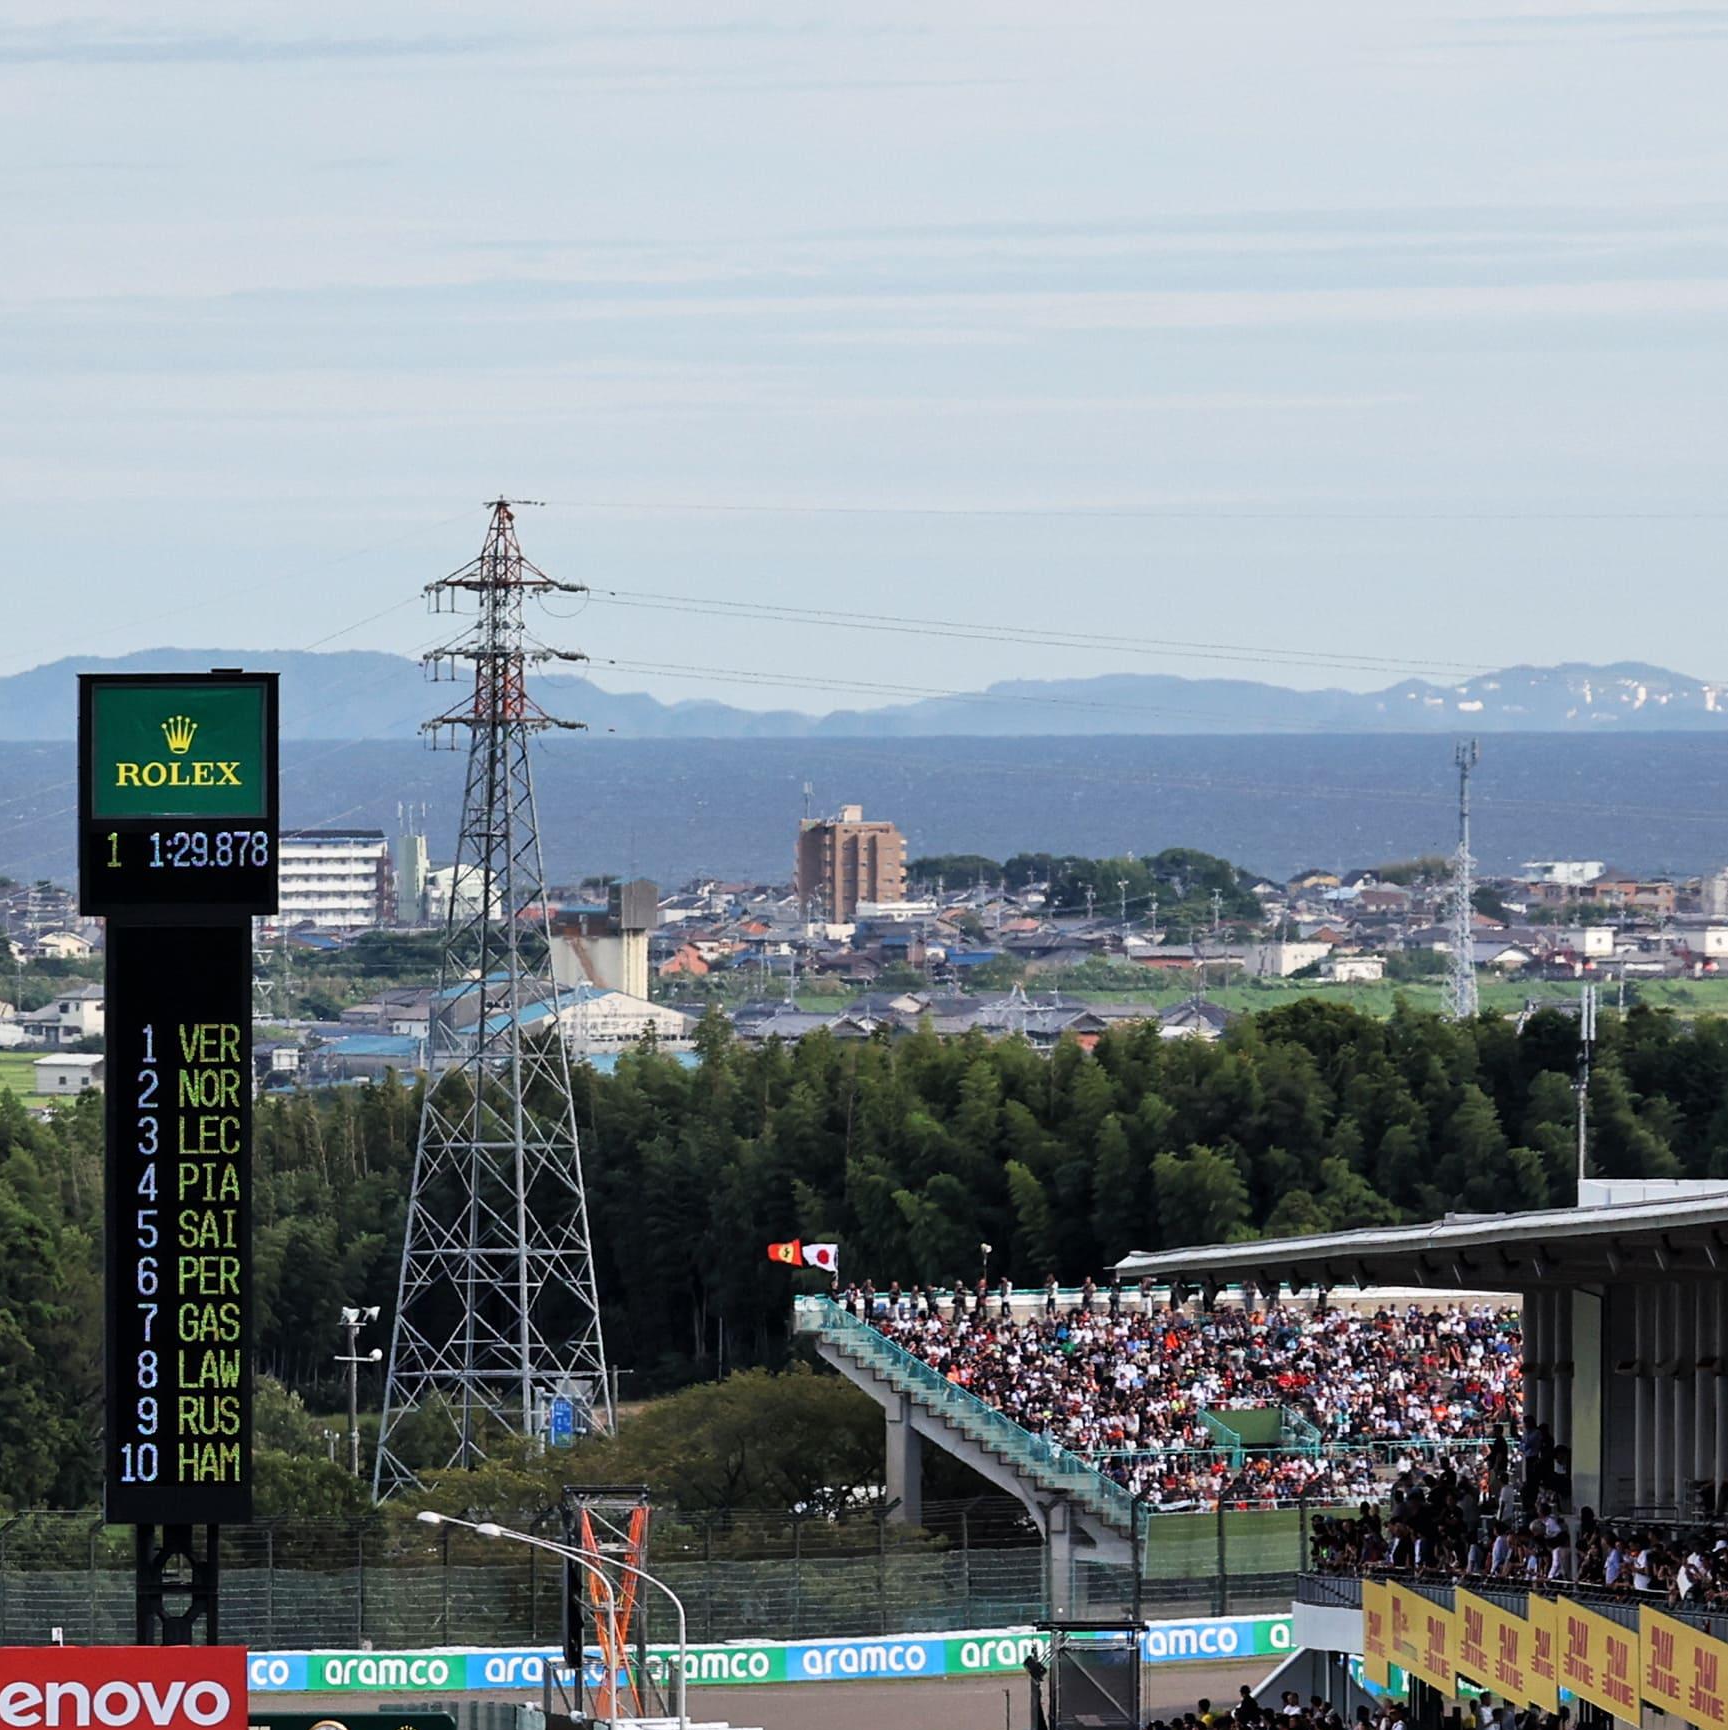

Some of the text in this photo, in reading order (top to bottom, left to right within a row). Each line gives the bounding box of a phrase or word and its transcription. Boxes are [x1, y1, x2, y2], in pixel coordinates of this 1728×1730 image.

[115, 762, 242, 787] ROLEX
[107, 831, 269, 867] 1 1:29.878
[142, 1023, 241, 1063] 1 VER
[137, 1069, 241, 1108] 2 NOR
[137, 1116, 241, 1154] 3 LEC
[137, 1162, 241, 1201] 4 PIA
[137, 1209, 237, 1248] 5 SAI
[137, 1256, 241, 1295] 6 PER
[137, 1303, 241, 1342] 7 GAS
[137, 1349, 241, 1389] 8 LAW
[137, 1396, 241, 1435] 9 RUS
[121, 1442, 241, 1482] 10 HAM
[325, 1659, 450, 1685] aramco
[802, 1645, 926, 1675] aramco
